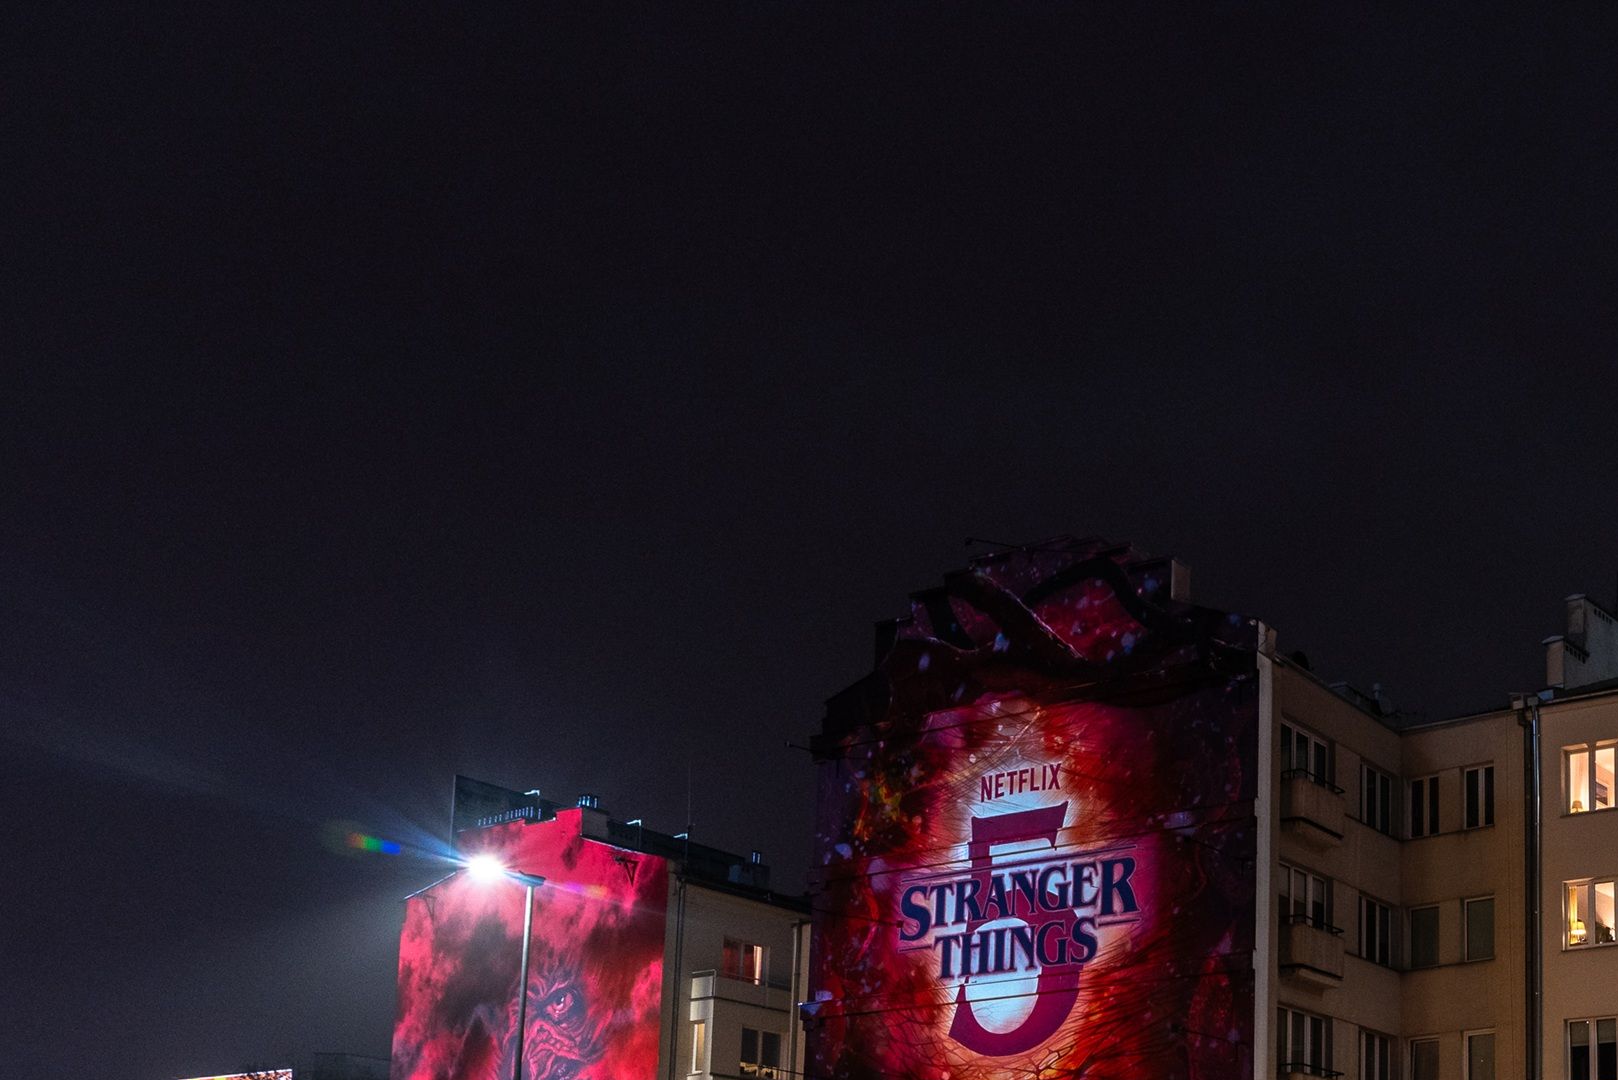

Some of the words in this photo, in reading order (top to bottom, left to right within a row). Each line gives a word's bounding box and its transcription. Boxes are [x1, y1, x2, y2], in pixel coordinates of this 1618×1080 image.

[980, 763, 1062, 802] NETFLIX
[899, 856, 1140, 941] STRANGER
[948, 801, 1070, 1056] 5
[935, 917, 1099, 980] THINGS
